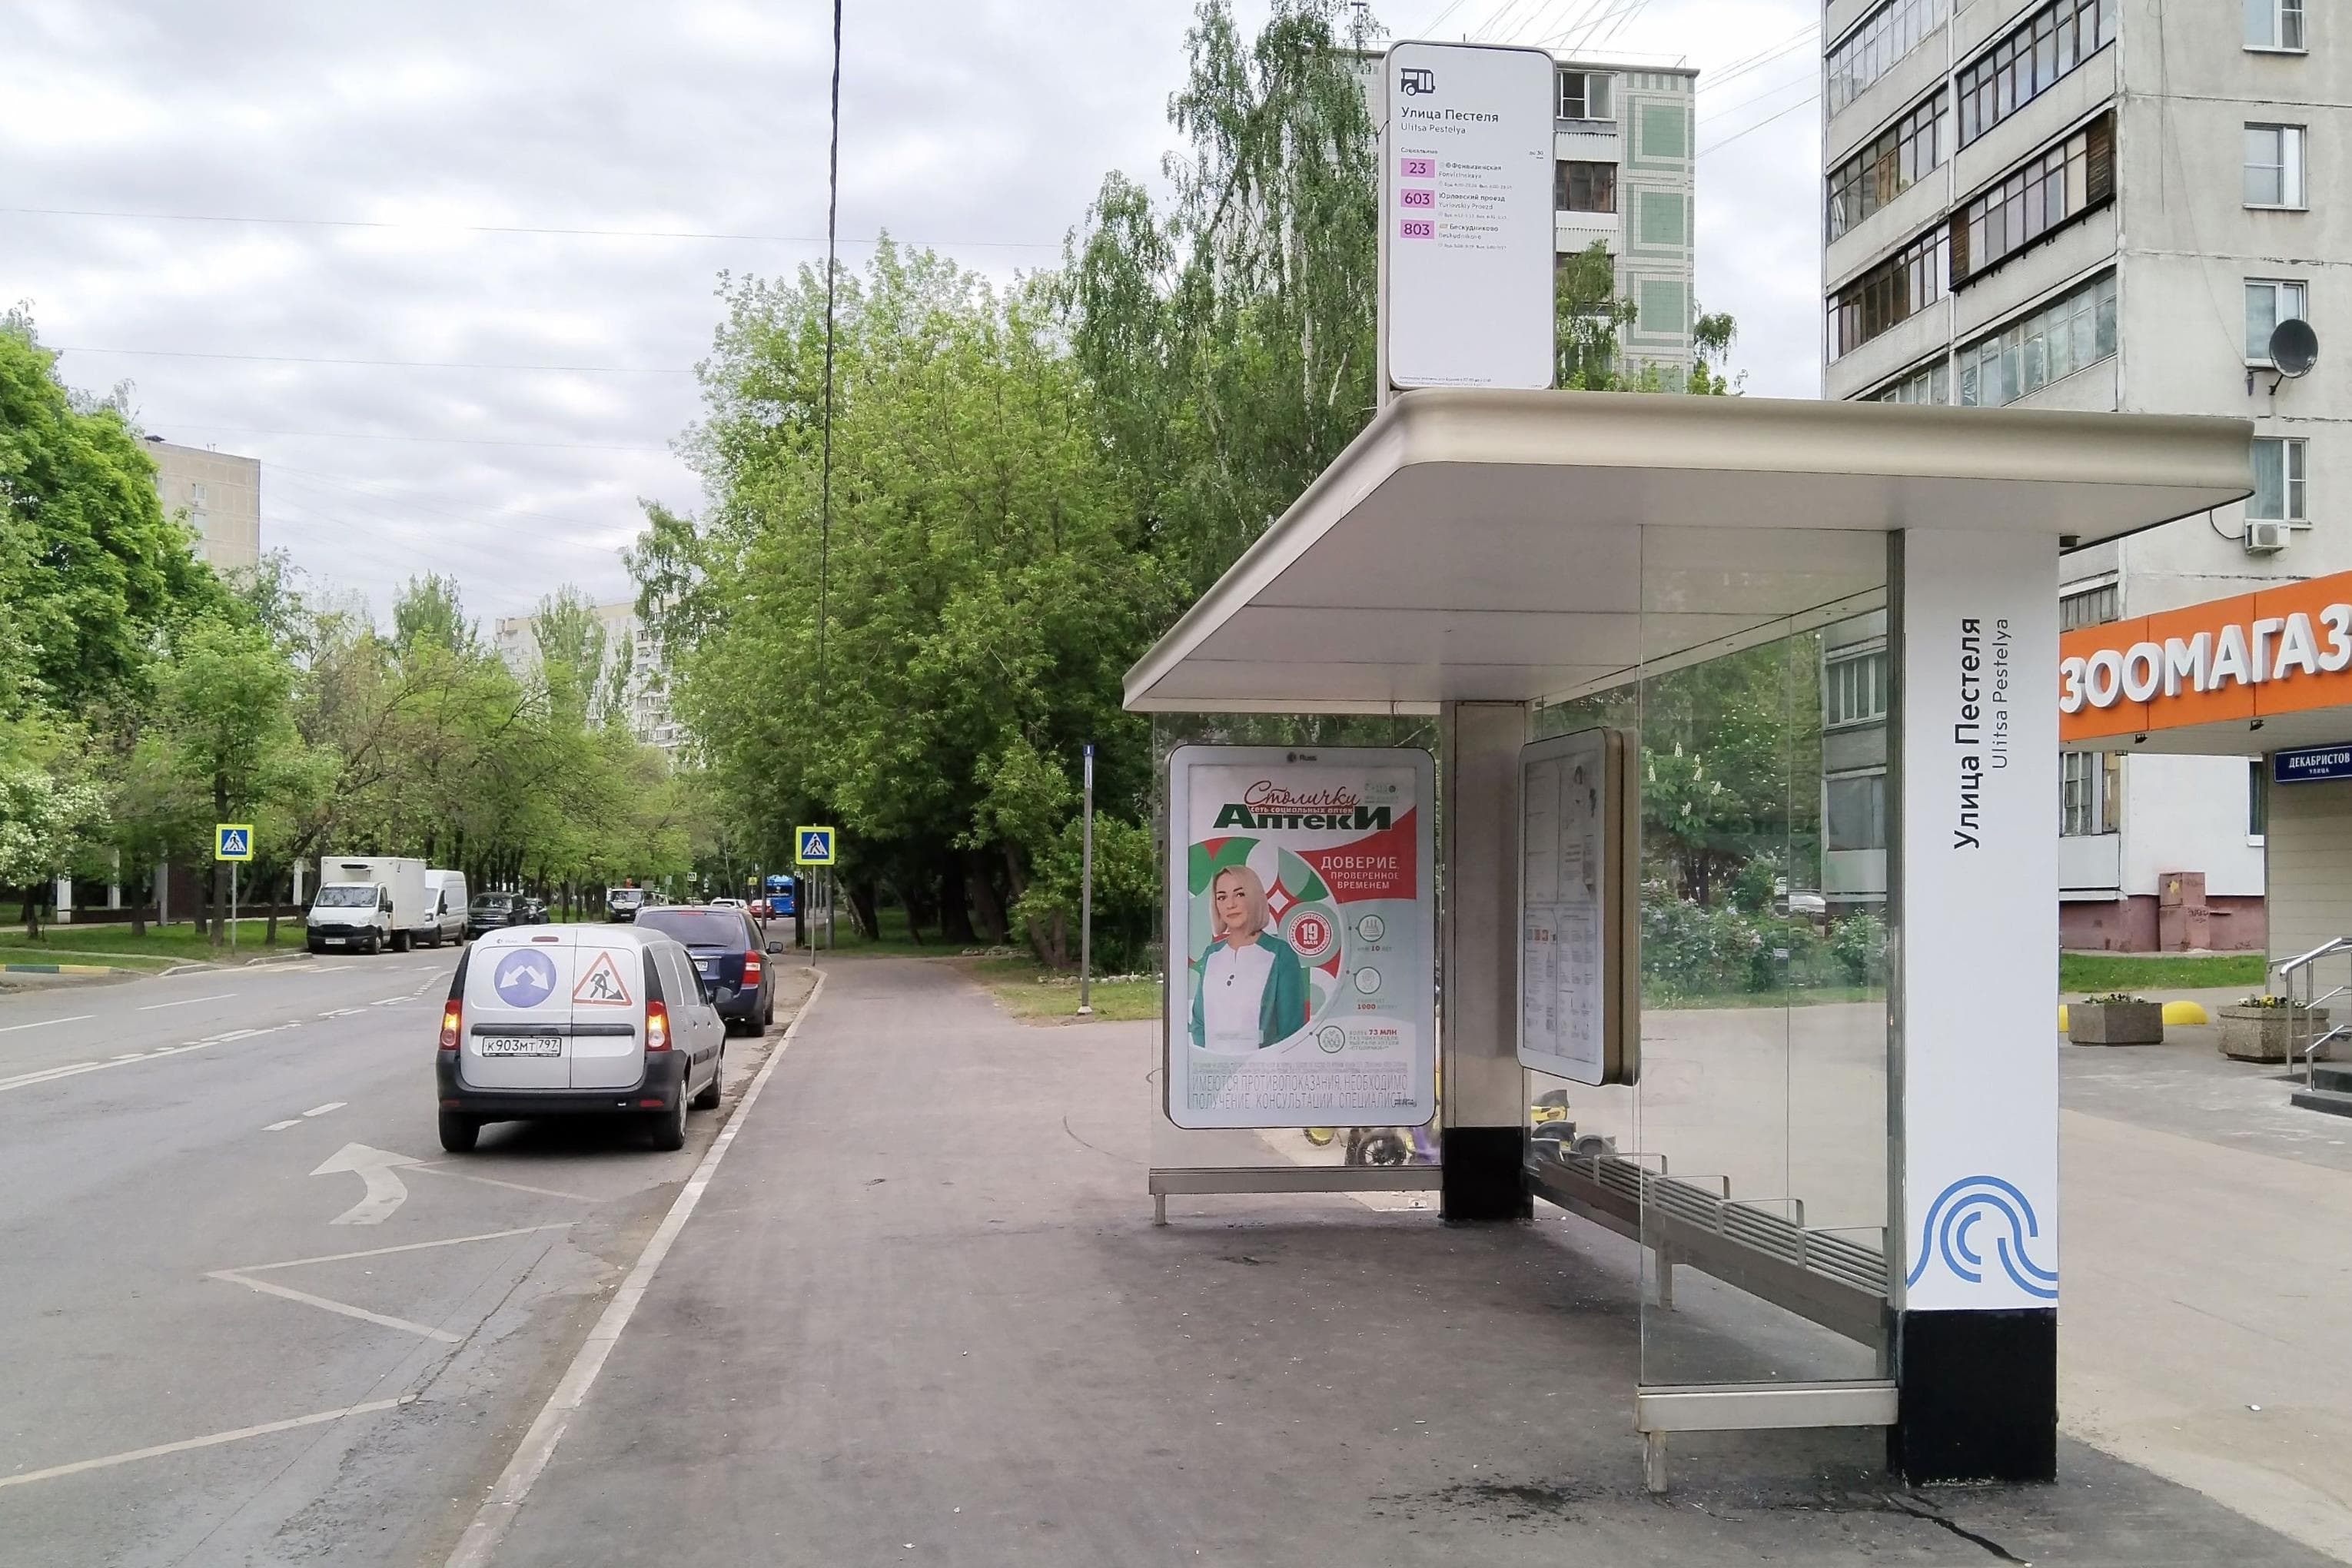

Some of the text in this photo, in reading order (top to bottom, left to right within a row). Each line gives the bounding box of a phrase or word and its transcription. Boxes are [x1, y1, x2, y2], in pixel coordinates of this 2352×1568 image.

[1401, 106, 1499, 122] Улица Пестеля
[1400, 122, 1466, 135] Ulitsa Pestelya
[1409, 162, 1427, 174] 23
[1404, 192, 1430, 204] 603
[1404, 223, 1430, 235] 803
[1992, 619, 2012, 769] Ulitsa Pestelya
[1954, 618, 1983, 849] Улица Пестеля
[2289, 752, 2350, 769] ДЕКАБРИСТОВ
[1244, 780, 1360, 806] Столички
[1330, 872, 1399, 880] ПРОВЕРЕННОЕ
[1337, 881, 1390, 889] ВРЕМЕНЕМ
[1301, 922, 1318, 940] 19
[538, 1039, 558, 1049] 797
[1192, 1075, 1239, 1091] ИМЕЮТСЯ
[1344, 1074, 1408, 1091] НЕОБХОДИМО
[1192, 1092, 1251, 1109] ПОЛУЧЕНИЕ
[1256, 1092, 1333, 1109] КОНСУЛЬТАЦИИ
